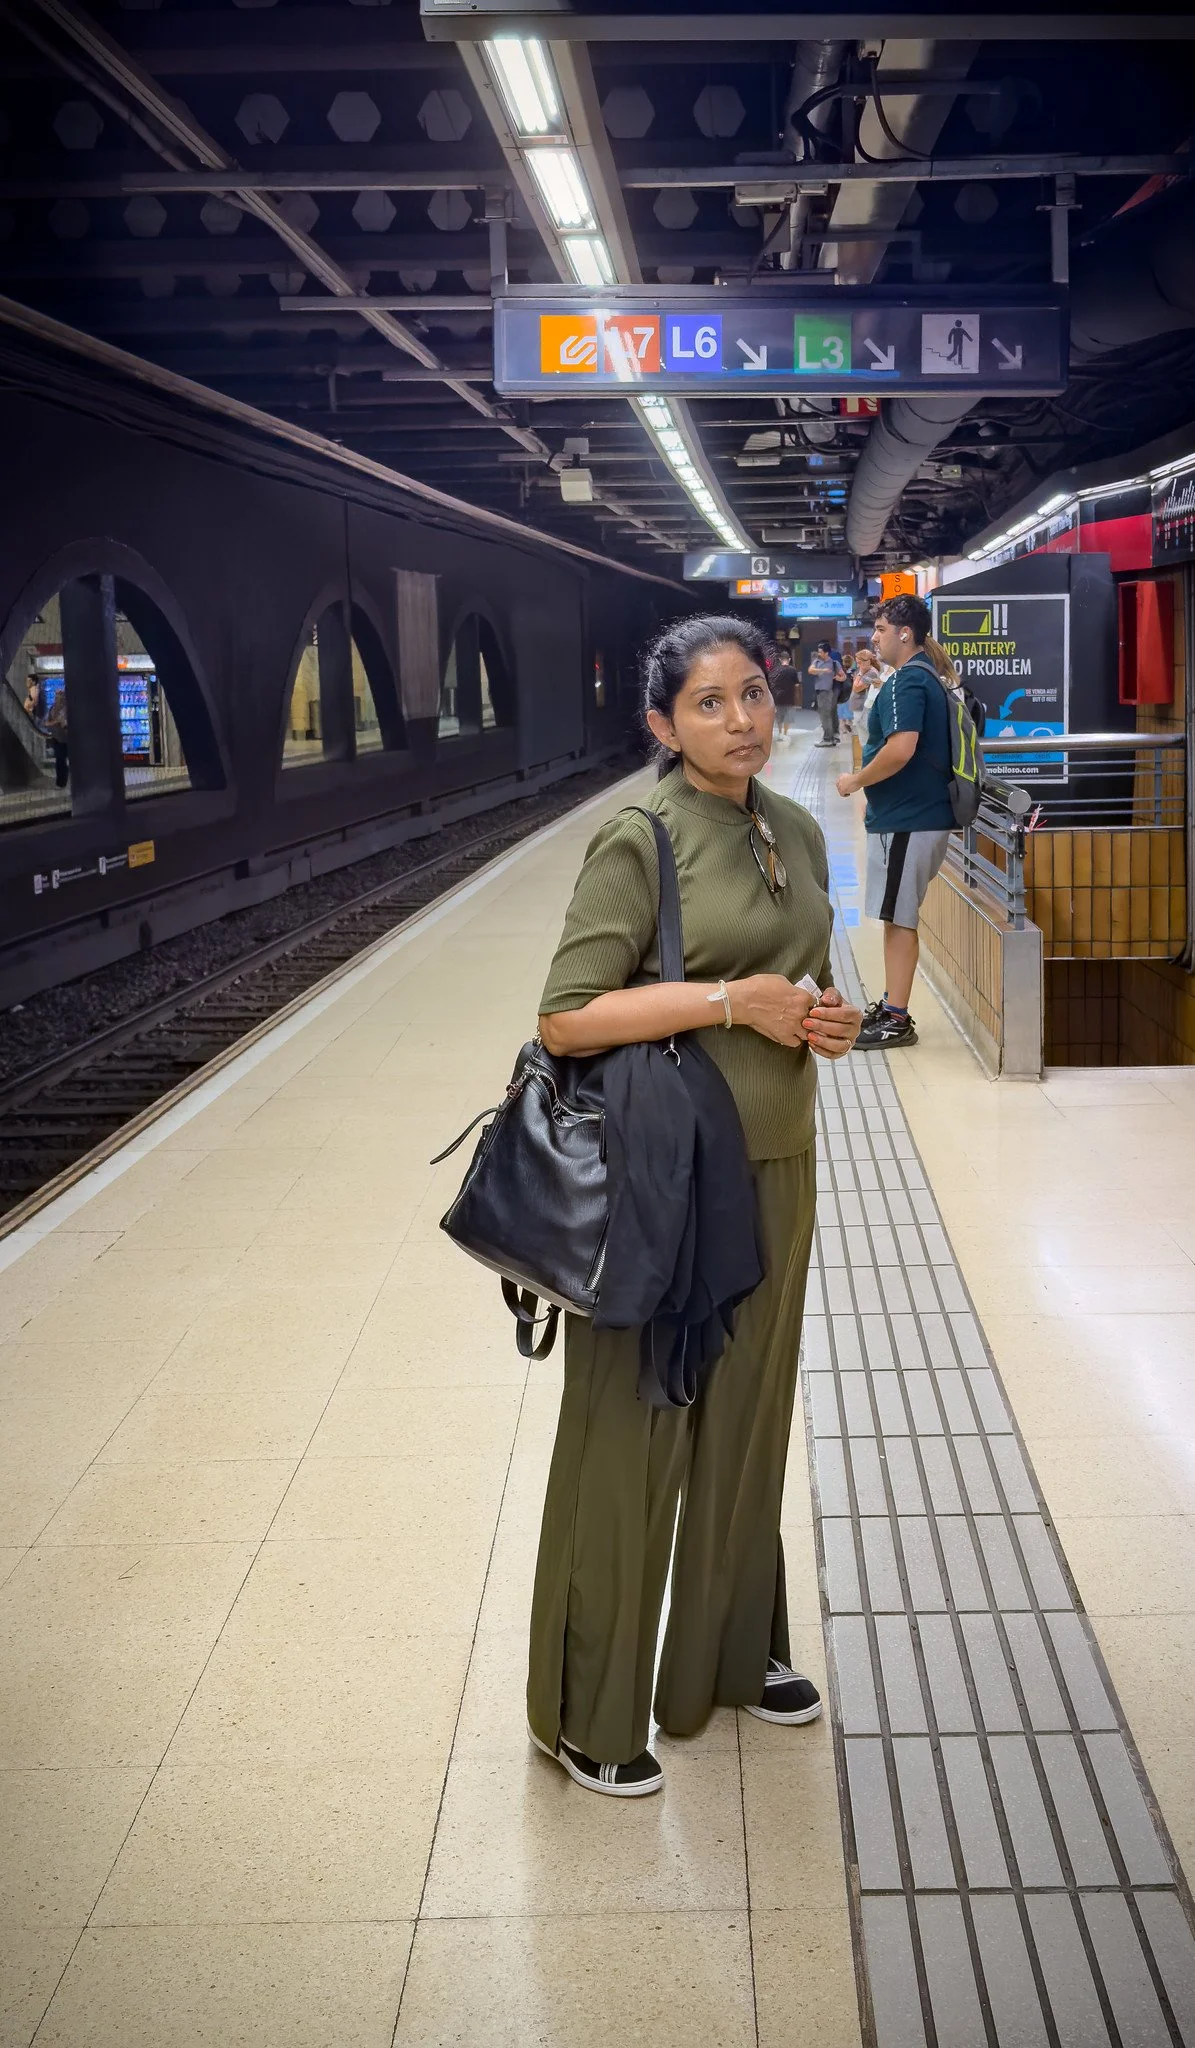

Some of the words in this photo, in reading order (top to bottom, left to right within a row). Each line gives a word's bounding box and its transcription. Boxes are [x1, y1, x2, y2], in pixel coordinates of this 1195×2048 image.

[672, 326, 718, 358] L6
[798, 335, 844, 369] L3
[943, 642, 959, 656] NO
[963, 641, 1016, 656] BATTERY?
[953, 659, 963, 676] O
[967, 658, 1032, 676] PROBLEM
